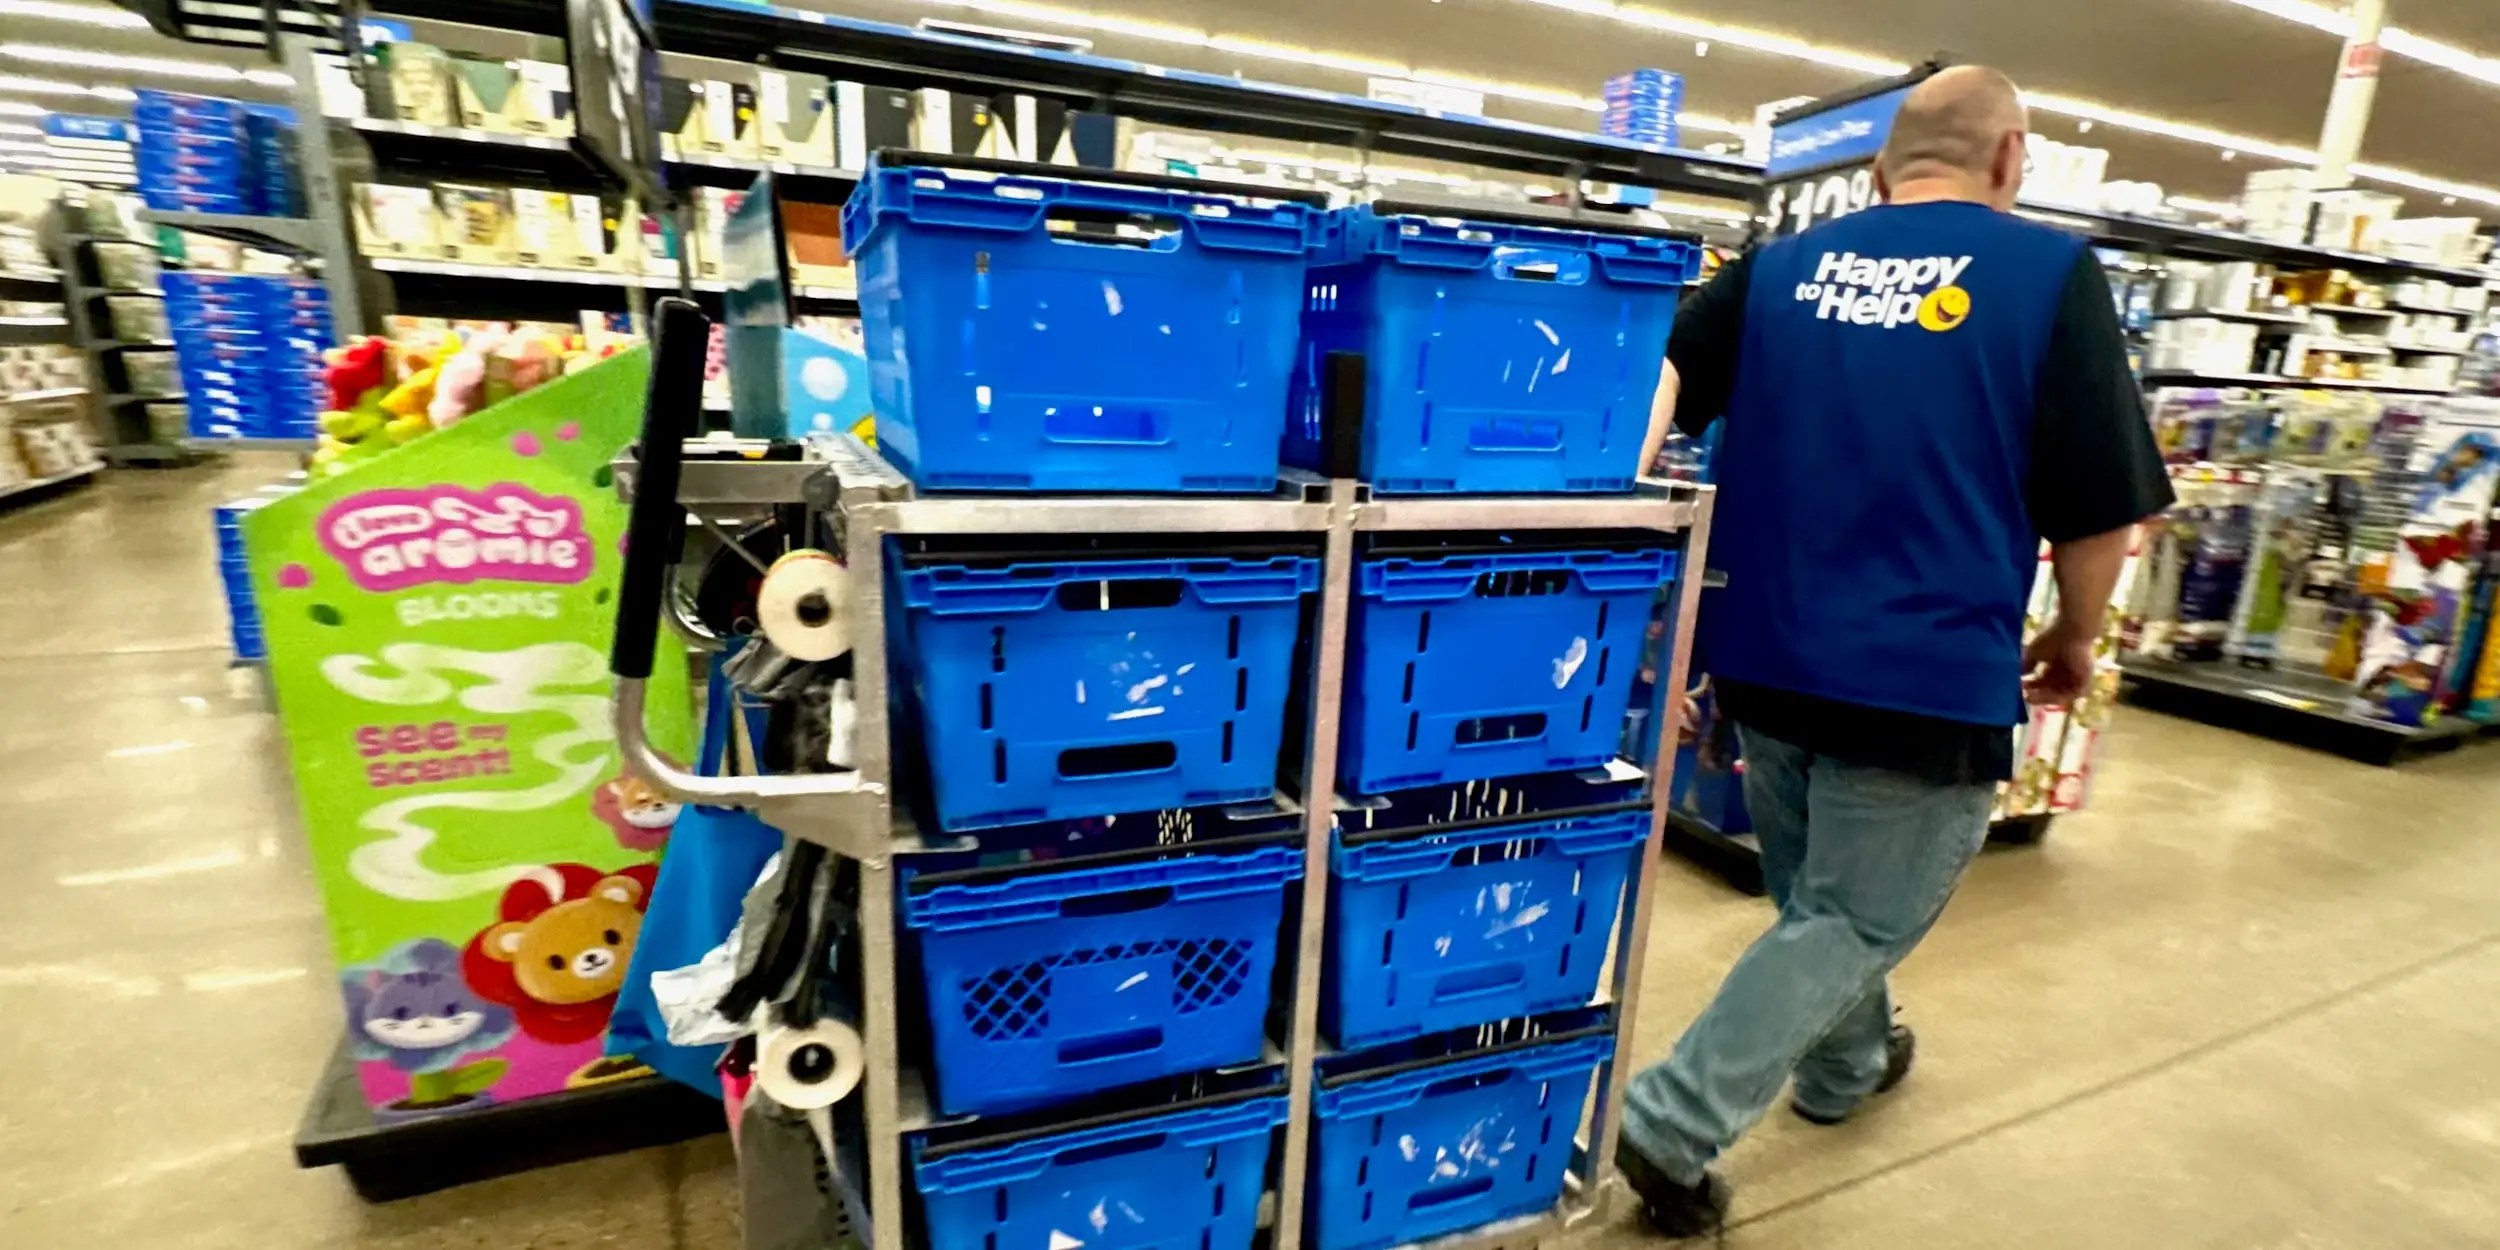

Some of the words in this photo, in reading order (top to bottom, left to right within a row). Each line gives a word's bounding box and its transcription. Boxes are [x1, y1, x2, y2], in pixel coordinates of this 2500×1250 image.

[1814, 252, 1973, 294] Happy
[1795, 282, 1821, 301] to
[1816, 284, 1922, 329] Help
[361, 528, 579, 576] aromie
[398, 592, 561, 625] BLOOMS
[355, 721, 463, 757] see
[367, 748, 512, 788] scent!
